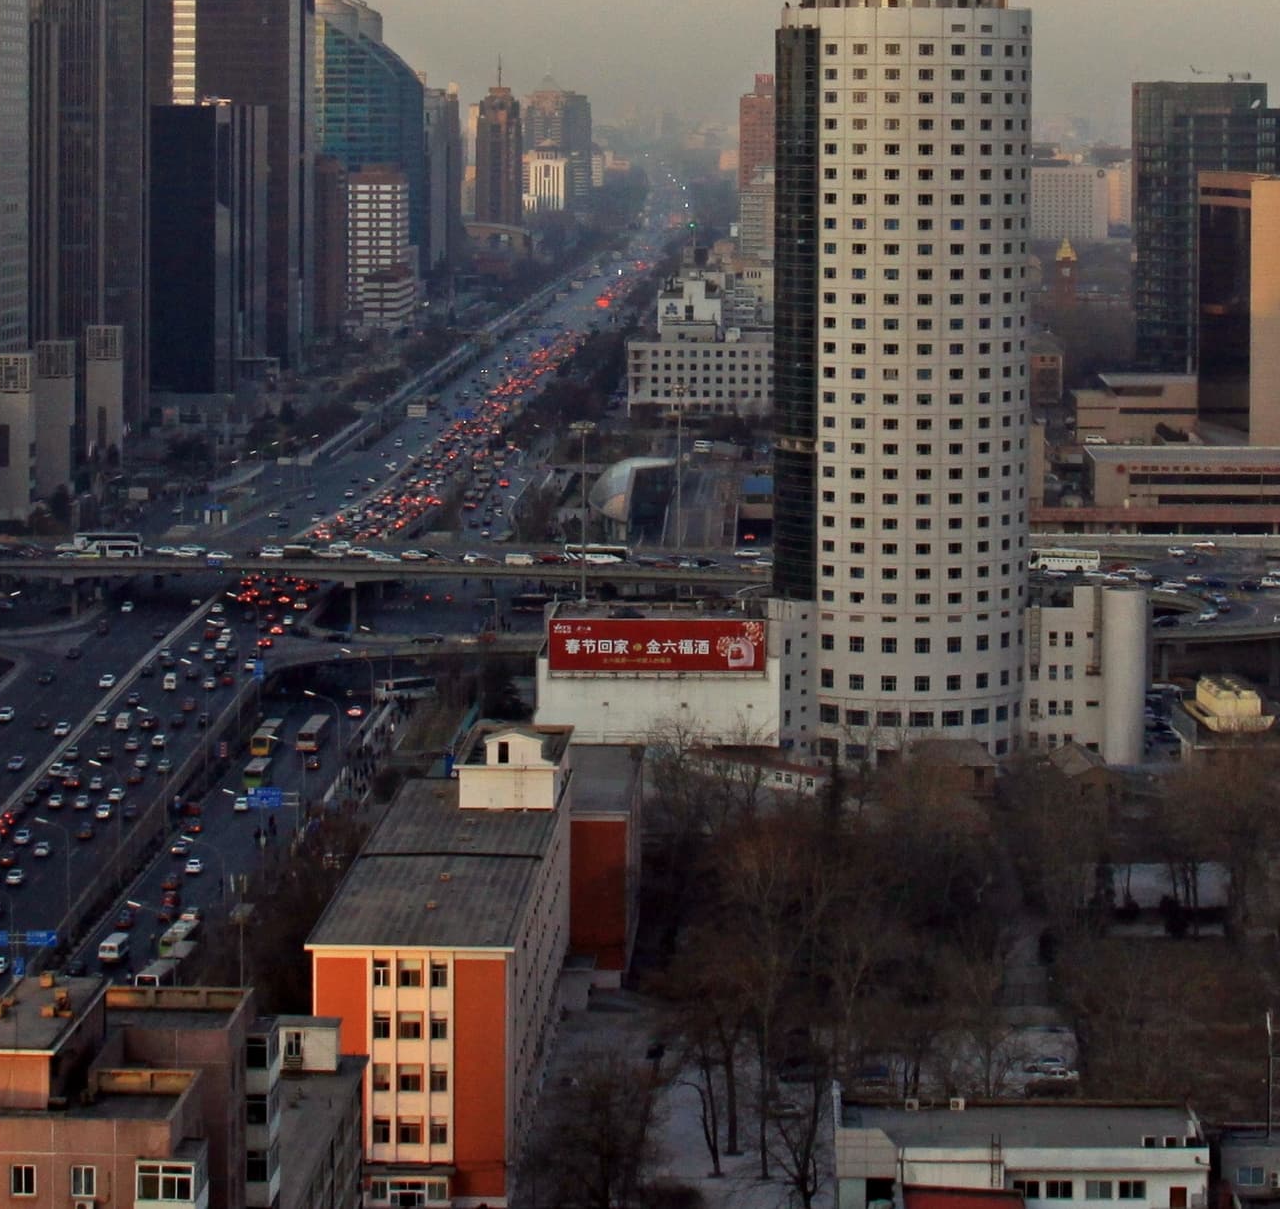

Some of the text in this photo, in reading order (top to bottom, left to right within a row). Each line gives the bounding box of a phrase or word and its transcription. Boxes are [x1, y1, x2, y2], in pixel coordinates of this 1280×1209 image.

[565, 638, 710, 655] 春节回家 金六福酒
